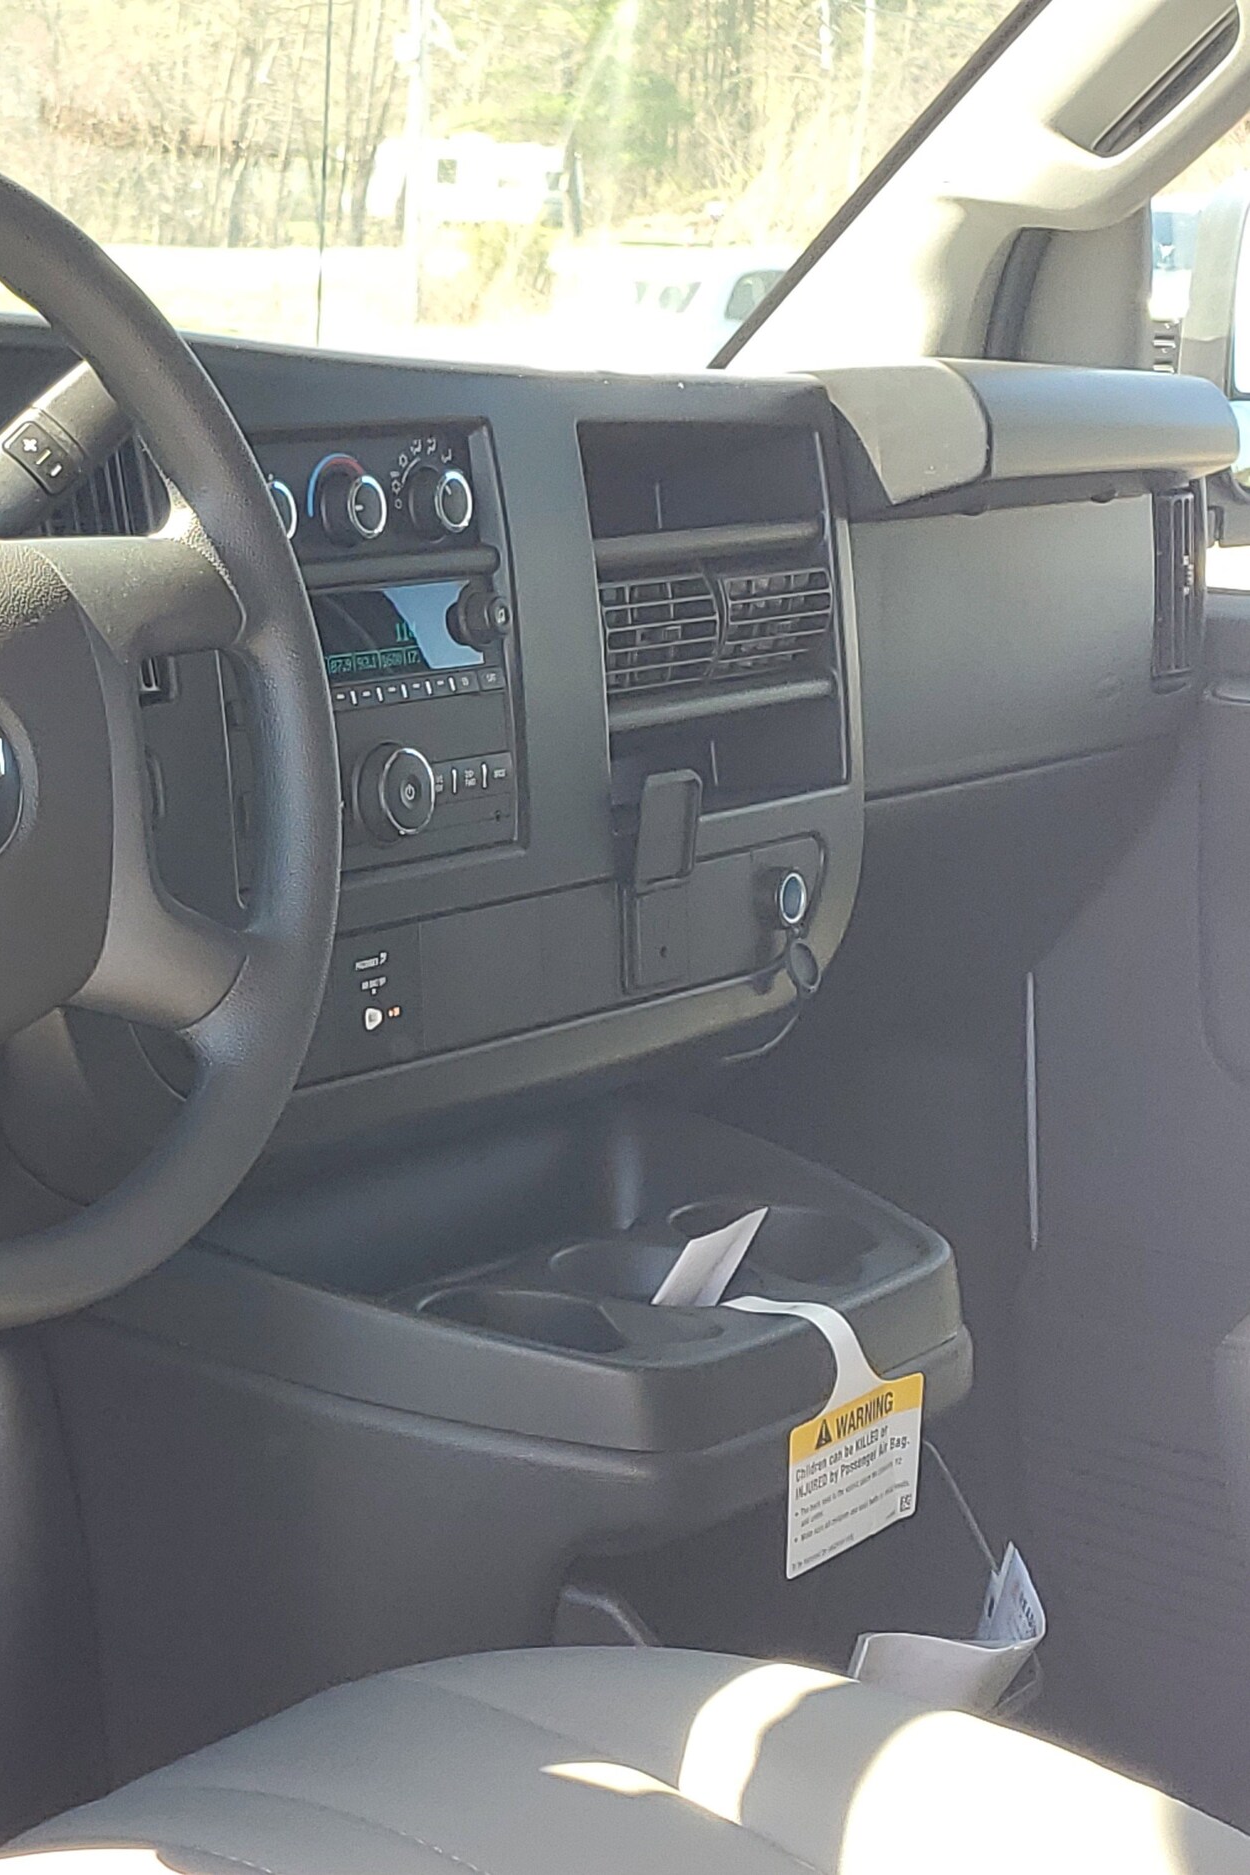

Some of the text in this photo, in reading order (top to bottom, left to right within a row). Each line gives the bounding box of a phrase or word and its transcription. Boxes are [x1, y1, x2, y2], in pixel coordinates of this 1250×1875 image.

[836, 1391, 893, 1439] WARNING
[795, 1458, 827, 1482] Children
[829, 1450, 842, 1466] can
[844, 1445, 854, 1458] be
[855, 1428, 879, 1451] KILLED
[881, 1425, 888, 1438] or
[795, 1474, 828, 1500] INJURED
[830, 1468, 839, 1484] by
[840, 1449, 877, 1478] Passenger
[878, 1441, 888, 1457] Air
[890, 1436, 910, 1450] Bag.
